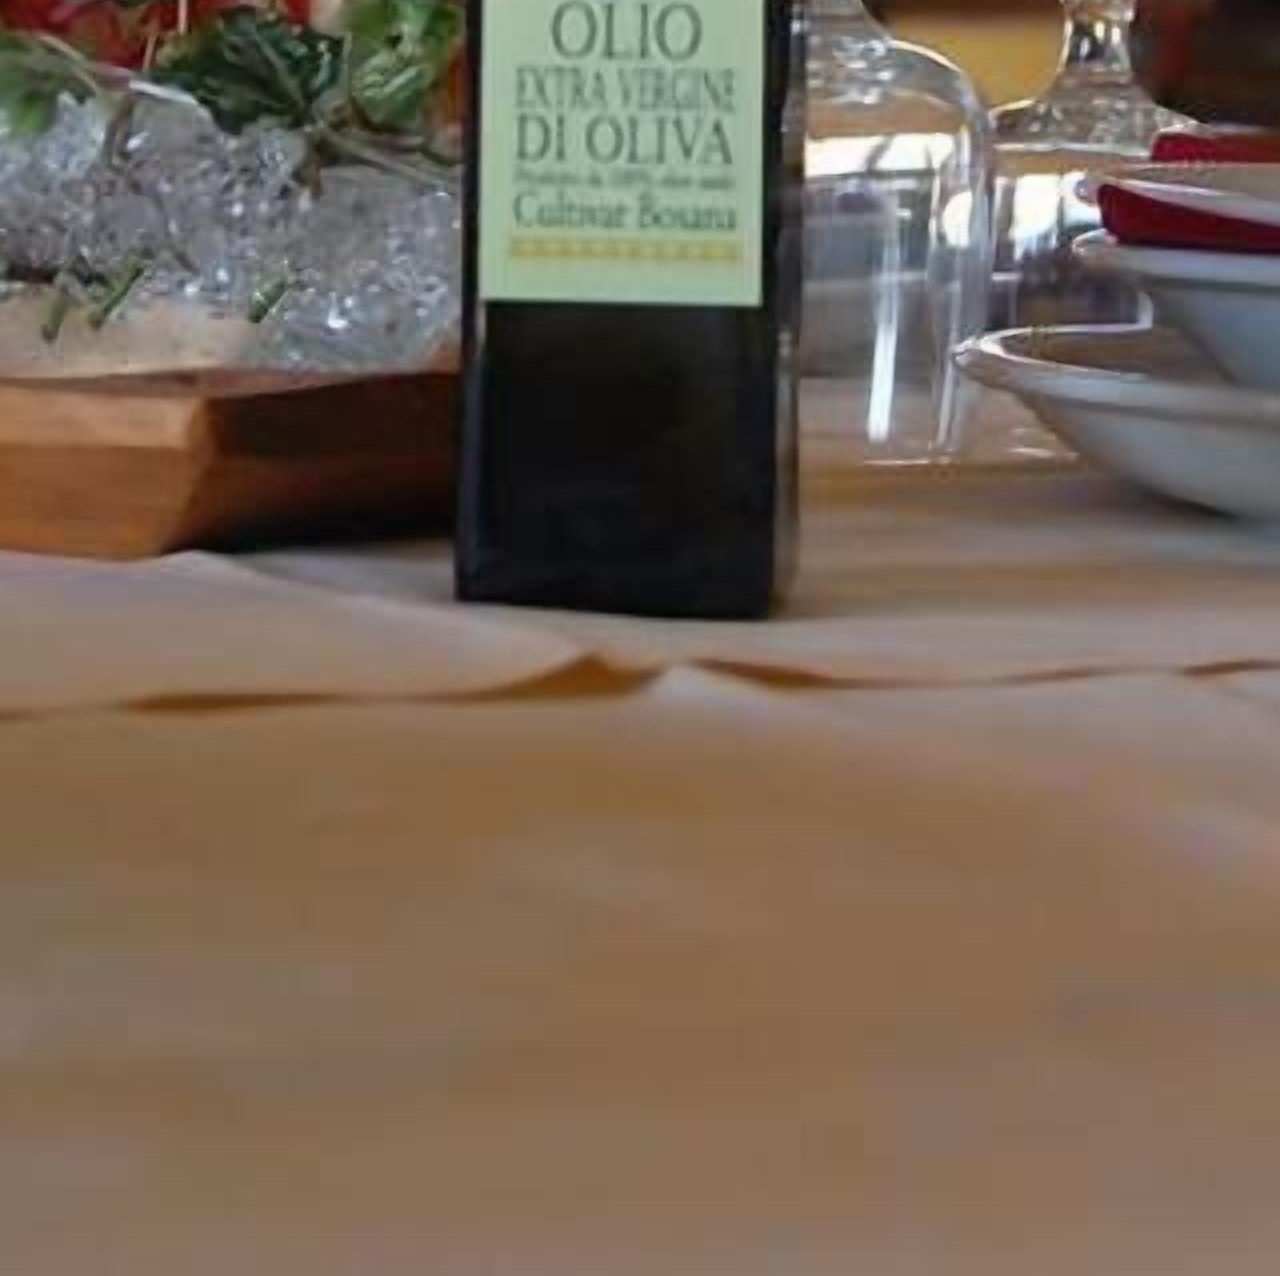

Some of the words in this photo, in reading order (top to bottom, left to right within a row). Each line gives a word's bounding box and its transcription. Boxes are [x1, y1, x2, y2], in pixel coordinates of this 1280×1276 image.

[550, 0, 703, 62] OLIO
[516, 66, 609, 110] EXTRA
[616, 67, 735, 112] VERGINE
[516, 115, 566, 163] DI
[584, 115, 733, 165] OLIVA
